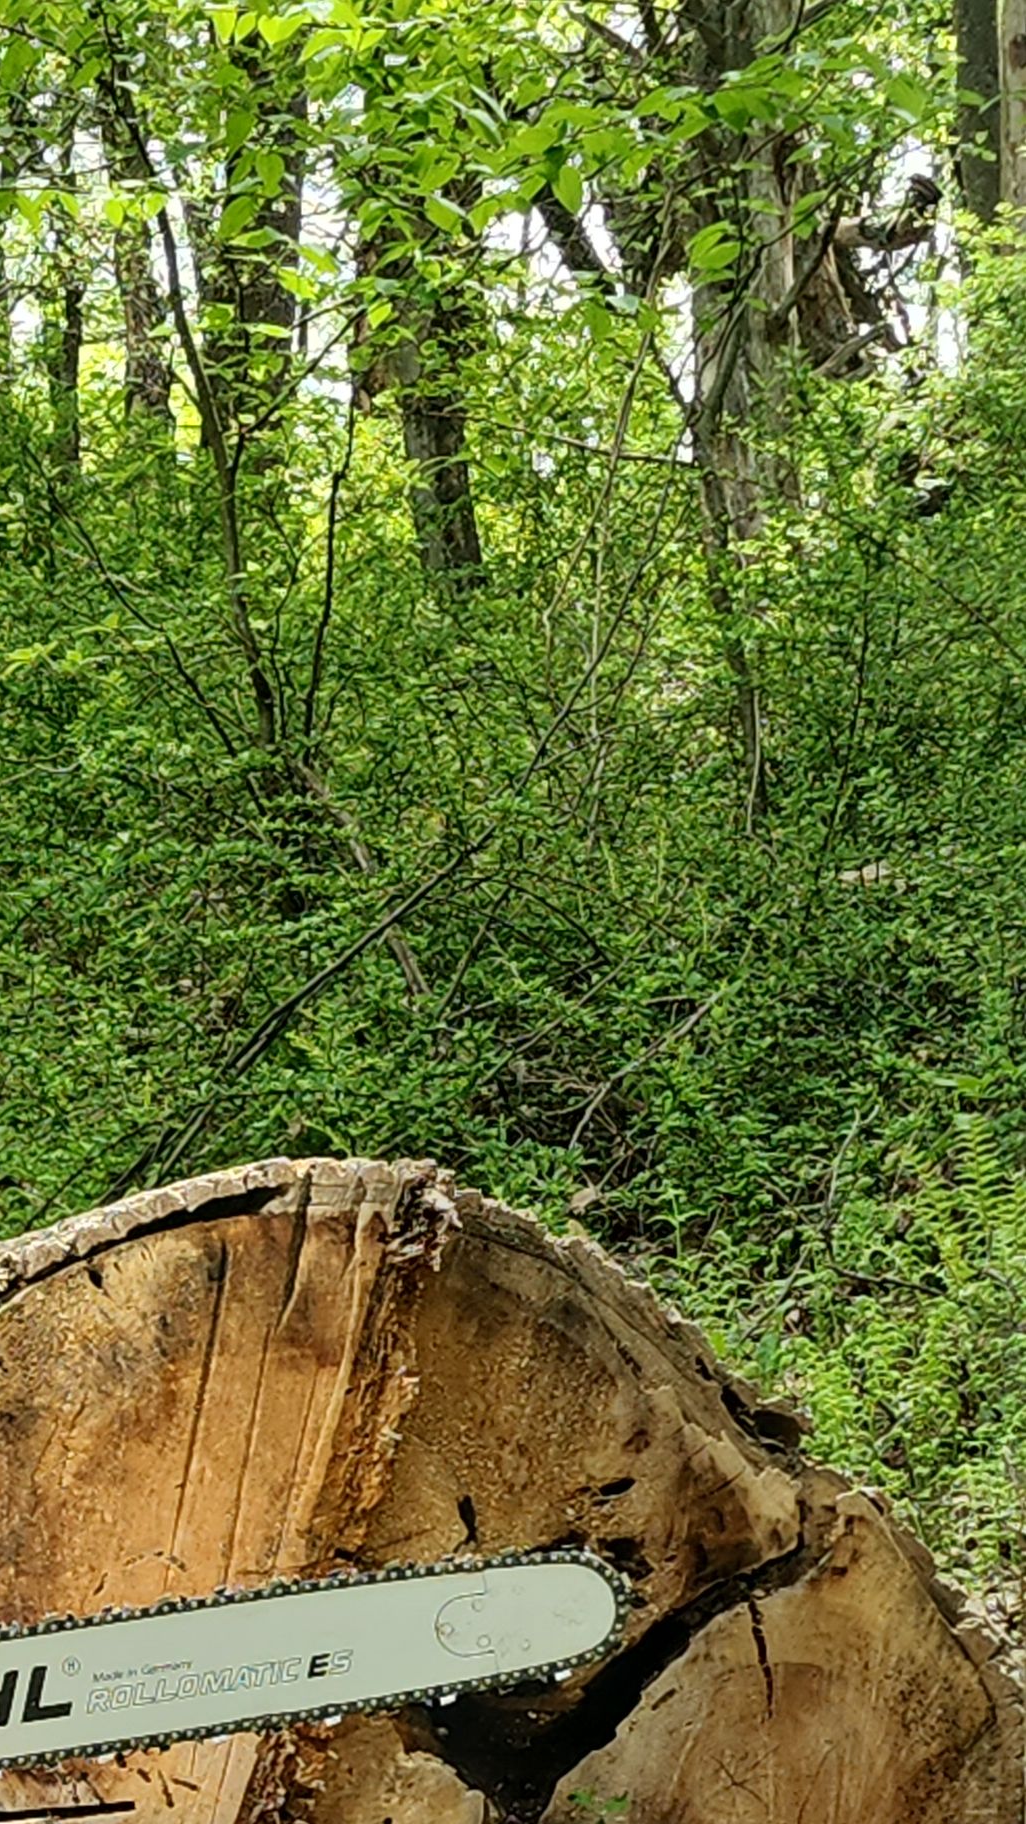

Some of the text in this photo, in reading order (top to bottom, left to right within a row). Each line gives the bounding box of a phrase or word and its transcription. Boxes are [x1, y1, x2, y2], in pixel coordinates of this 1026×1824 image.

[86, 1650, 353, 1714] ROLLOMATIC ES
[93, 1671, 123, 1683] Made
[141, 1660, 192, 1675] Germany
